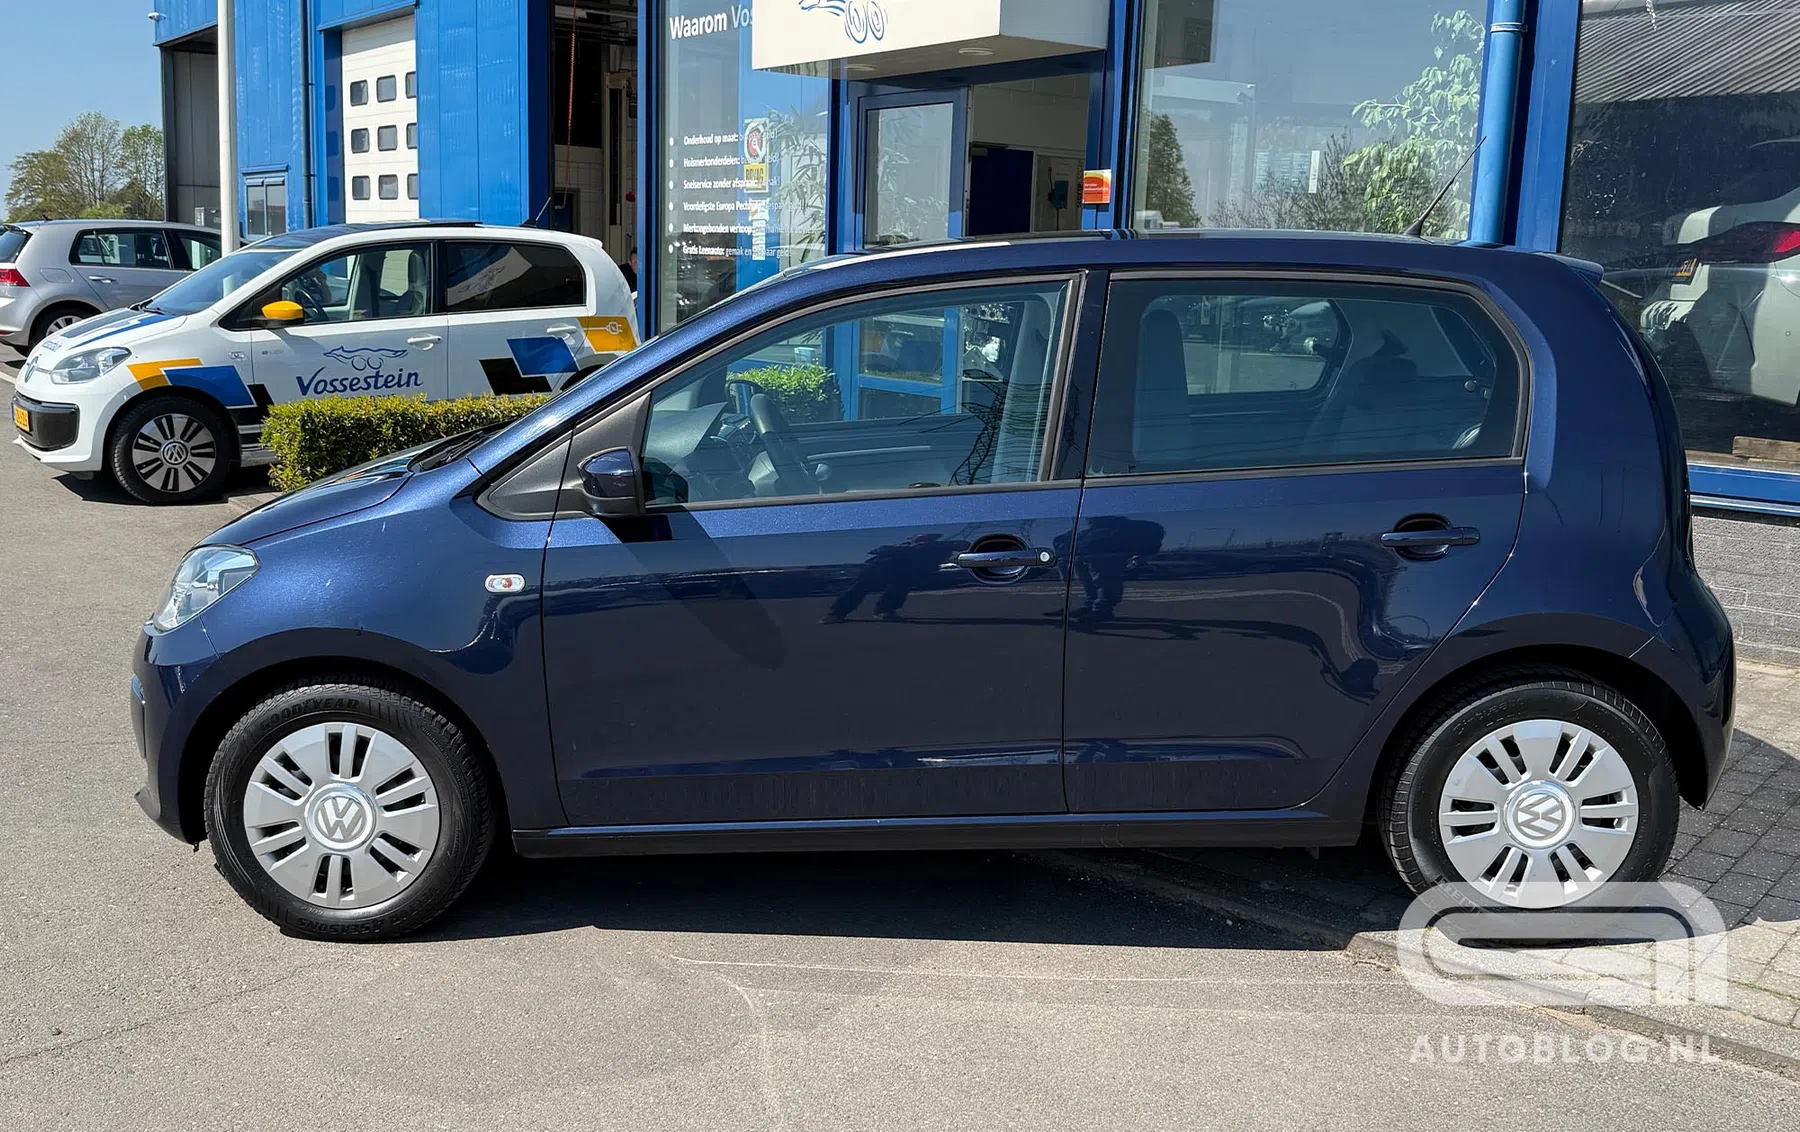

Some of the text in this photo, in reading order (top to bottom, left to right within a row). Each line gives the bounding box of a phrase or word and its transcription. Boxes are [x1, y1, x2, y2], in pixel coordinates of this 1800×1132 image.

[669, 12, 727, 39] Waarom
[684, 134, 713, 145] Onderhoud
[714, 136, 722, 145] op
[722, 133, 738, 143] maat:
[684, 179, 712, 189] Snelservice
[713, 178, 731, 188] zonder
[683, 201, 715, 212] Voordeligste
[716, 201, 735, 212] Europa
[683, 244, 698, 255] Gratis
[698, 245, 725, 255] Leenauto:
[725, 246, 744, 257] gemak
[744, 248, 752, 256] en
[296, 367, 423, 396] Vossestein
